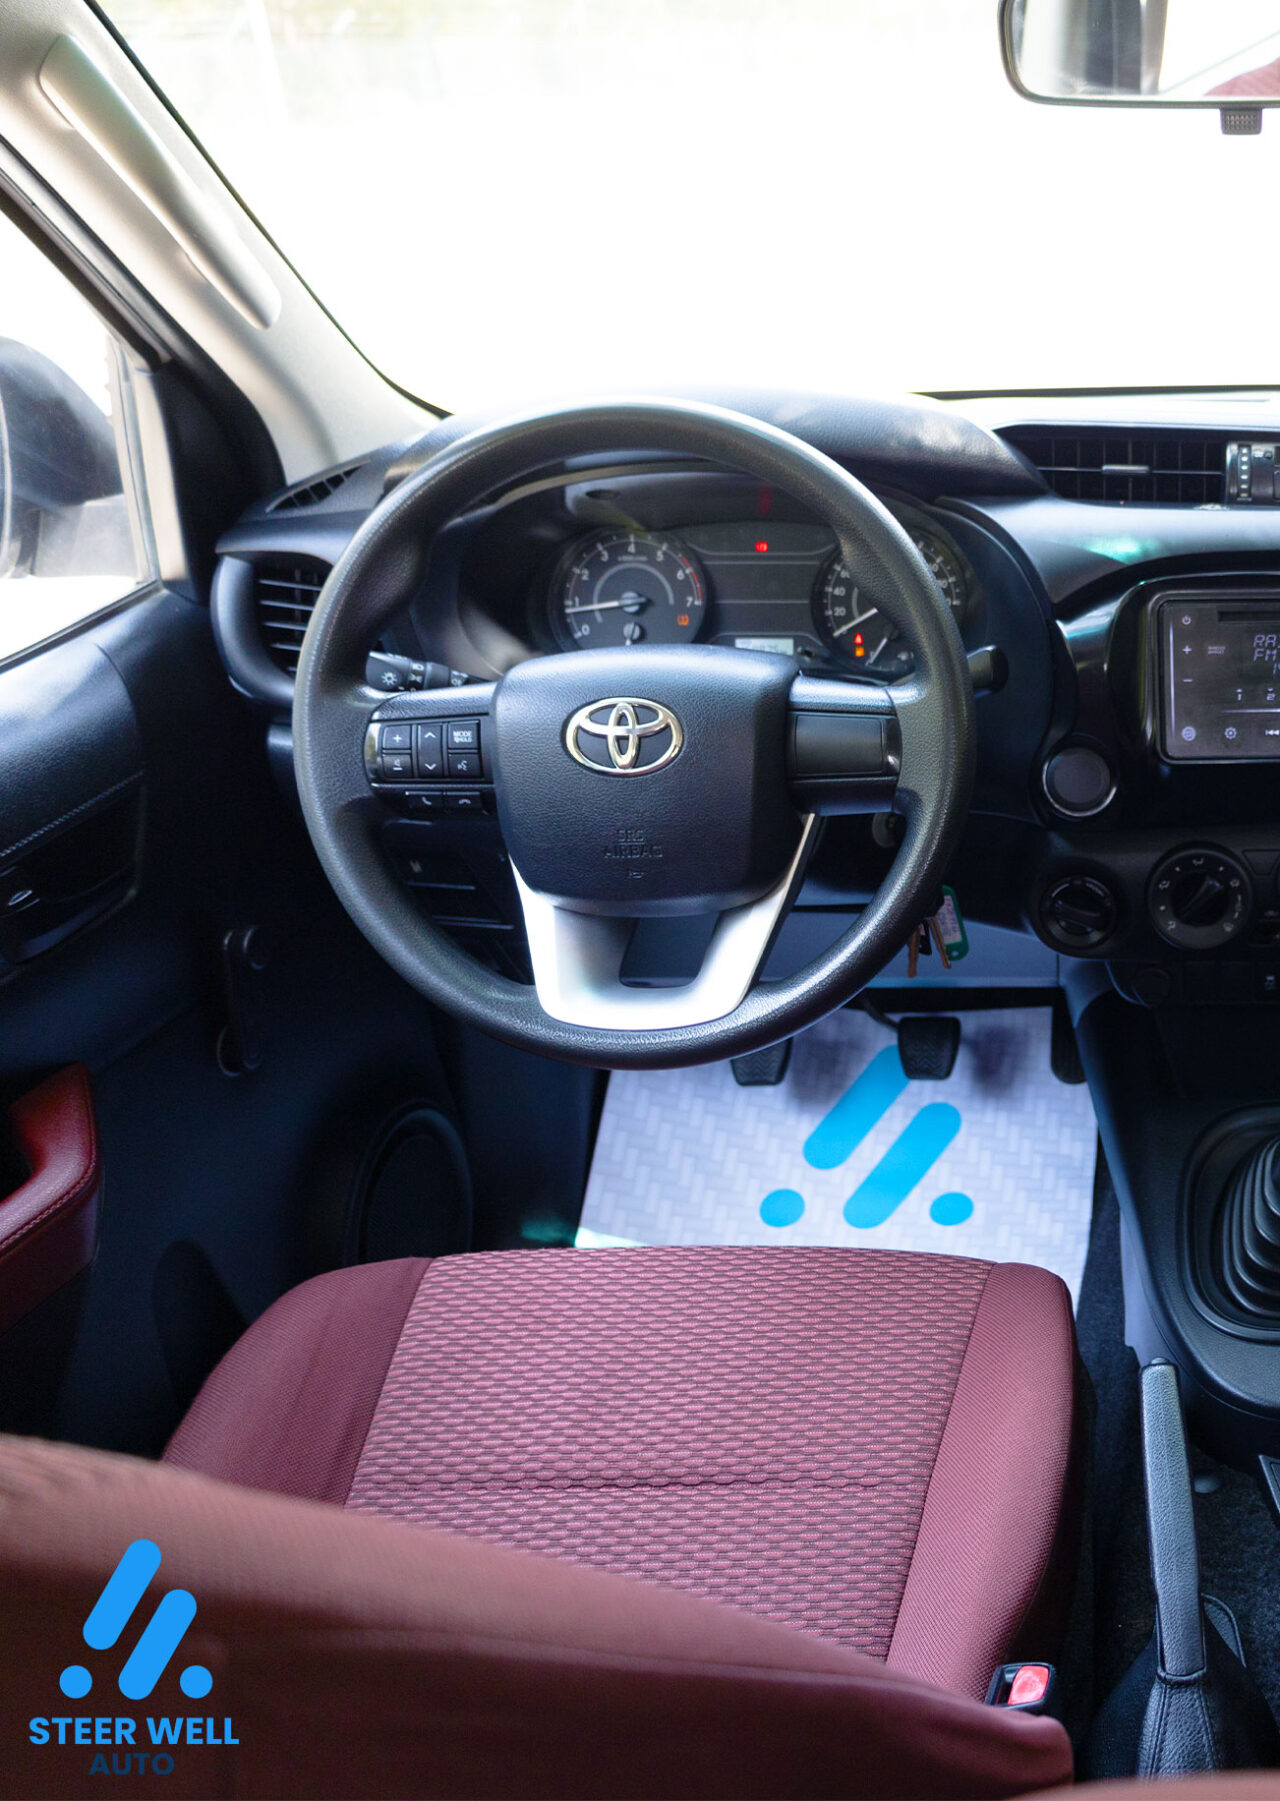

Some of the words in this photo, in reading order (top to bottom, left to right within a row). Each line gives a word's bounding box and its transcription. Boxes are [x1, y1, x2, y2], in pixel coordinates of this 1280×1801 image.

[601, 551, 609, 562] 3
[656, 551, 664, 562] 5
[677, 570, 685, 581] 6
[833, 586, 846, 597] 40
[685, 597, 694, 608] 7
[833, 606, 846, 617] 20
[604, 846, 664, 858] AIRBAG
